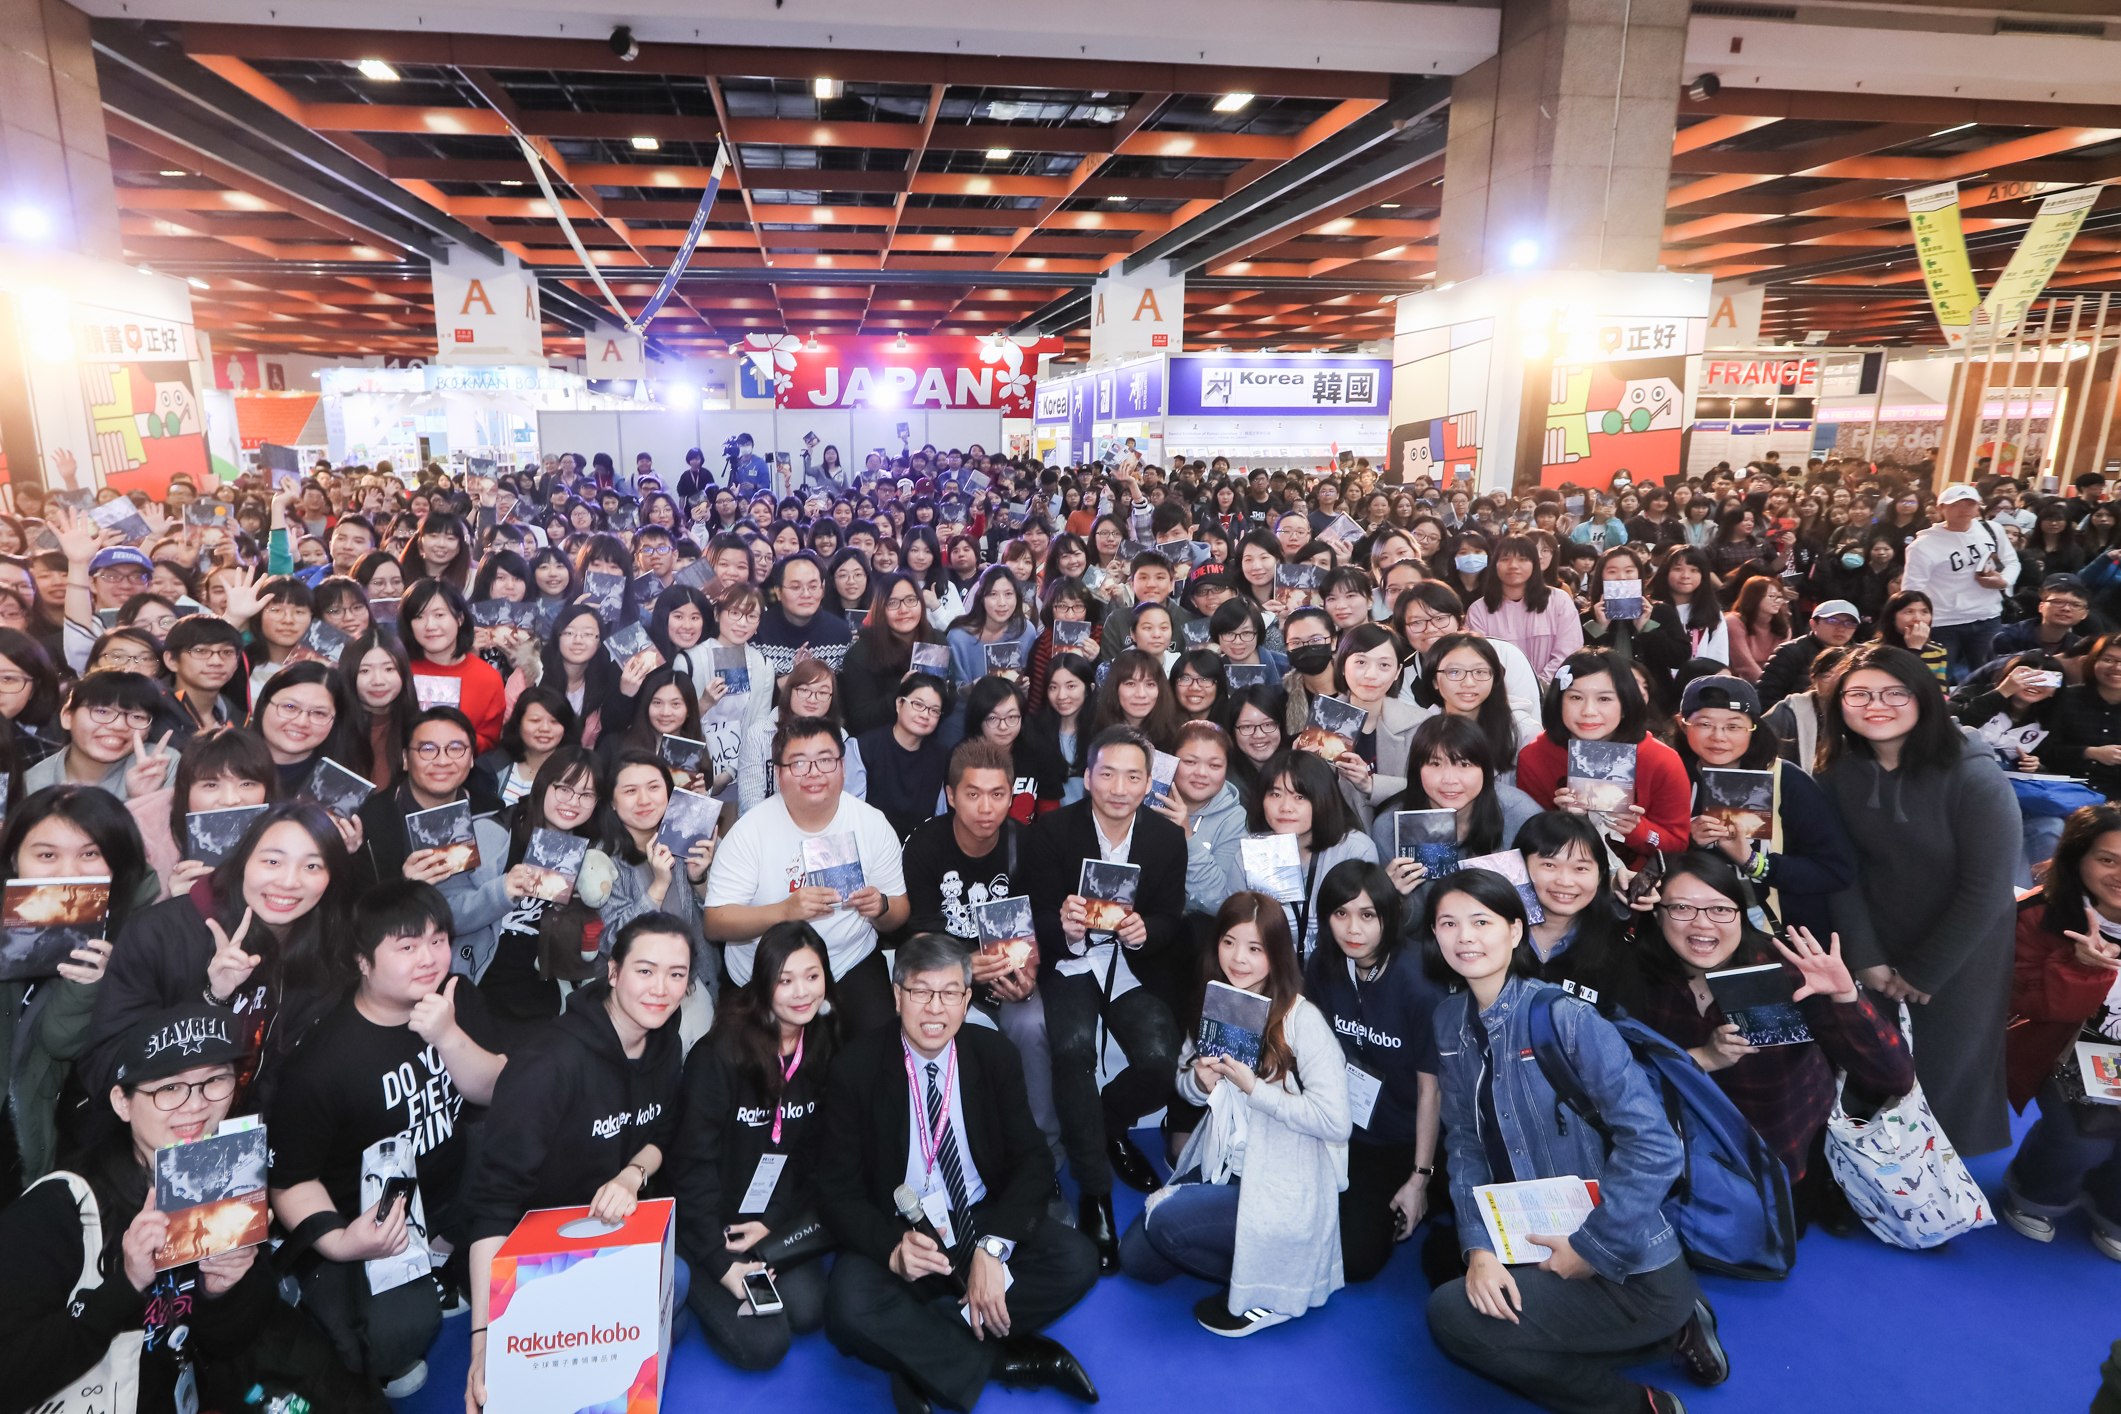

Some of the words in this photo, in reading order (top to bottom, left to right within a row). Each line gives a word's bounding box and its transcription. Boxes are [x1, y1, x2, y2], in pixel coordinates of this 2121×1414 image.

[459, 279, 497, 315] A
[525, 285, 536, 321] A
[1095, 293, 1106, 326] A
[1131, 288, 1163, 321] A
[1710, 296, 1738, 328] A
[144, 326, 177, 353] 正好
[601, 339, 623, 361] A
[1626, 324, 1676, 352] 正好
[436, 376, 509, 390] BOOKMAN
[807, 367, 994, 406] JAPAN
[1239, 371, 1304, 385] Korea
[1708, 361, 1817, 385] FRANCE
[1312, 371, 1374, 404] 韓國
[1043, 394, 1067, 416] Korea
[1831, 410, 1853, 419] FREE
[1854, 409, 1900, 419] DELIERY
[1902, 408, 1915, 418] TO
[1918, 407, 1947, 417] TAIWA
[1368, 1027, 1402, 1049] kobo
[382, 1062, 417, 1110] DO
[787, 1101, 815, 1119] koo
[592, 1112, 632, 1139] Rakue
[783, 1222, 821, 1247] MOMA
[506, 1330, 589, 1359] Rakuten
[591, 1321, 641, 1345] kobo
[532, 1353, 618, 1371] 全球電子書領導品牌
